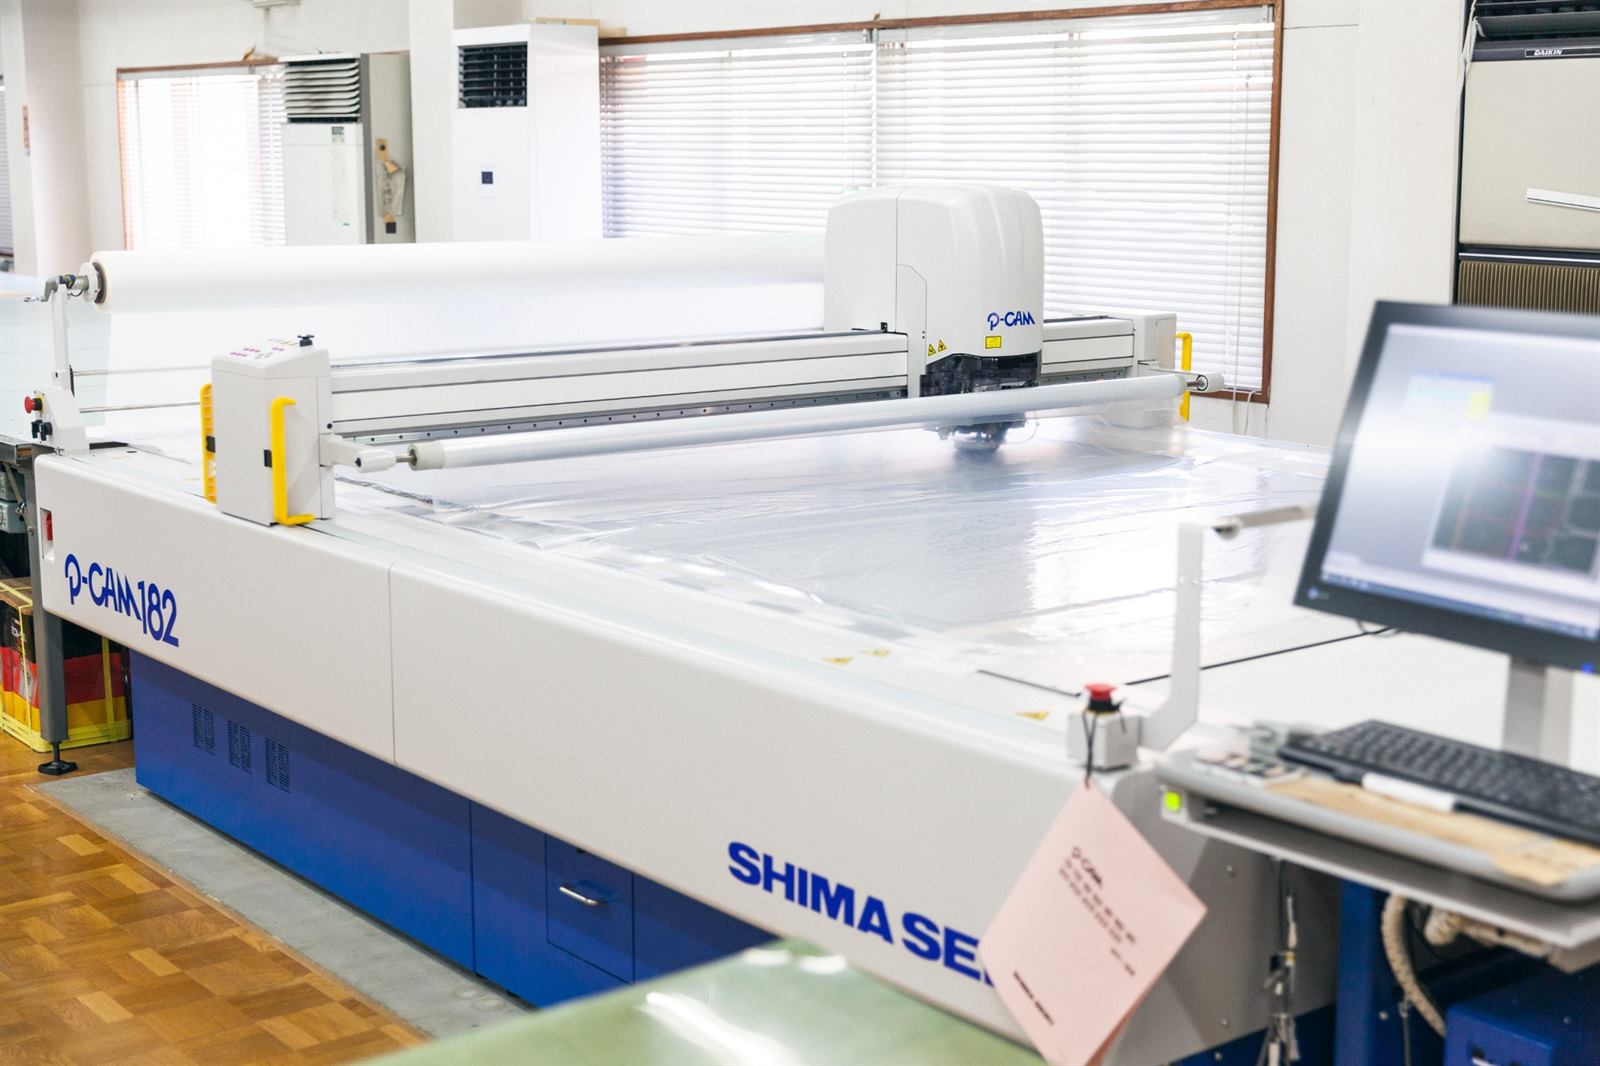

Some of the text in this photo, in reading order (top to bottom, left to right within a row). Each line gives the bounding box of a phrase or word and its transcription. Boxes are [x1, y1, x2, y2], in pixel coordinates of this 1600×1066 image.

[1534, 48, 1563, 57] DAIKIN
[728, 841, 994, 988] SHIMA SE
